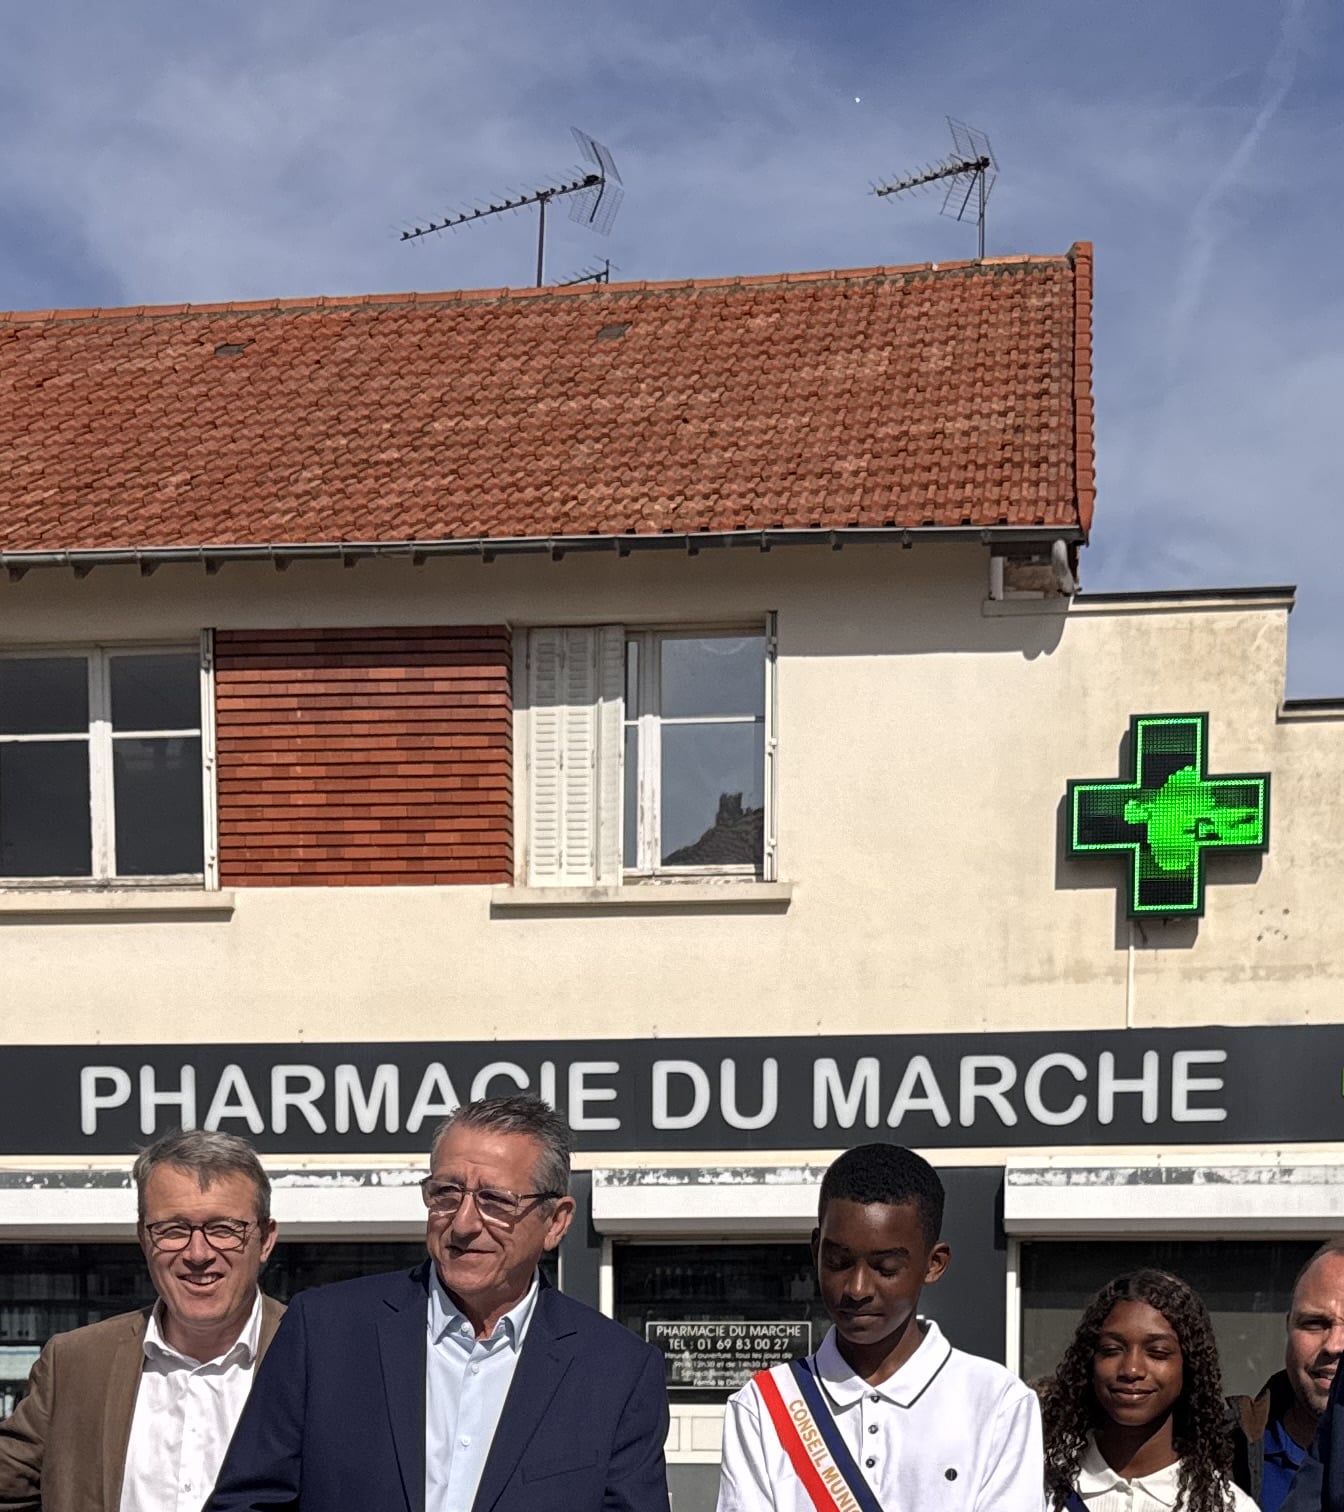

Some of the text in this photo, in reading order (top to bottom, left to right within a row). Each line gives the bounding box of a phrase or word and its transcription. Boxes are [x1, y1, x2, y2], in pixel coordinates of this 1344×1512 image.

[80, 1049, 1227, 1135] PHARMACIE DU MARCHE
[656, 1325, 801, 1337] PHARMACIE DU MARCHE
[669, 1338, 686, 1350] TEL
[697, 1338, 711, 1350] 01
[716, 1338, 732, 1350] 69
[735, 1338, 751, 1350] 83
[754, 1338, 771, 1350] 00
[773, 1338, 789, 1350] 27
[789, 1399, 829, 1468] CONSEIL
